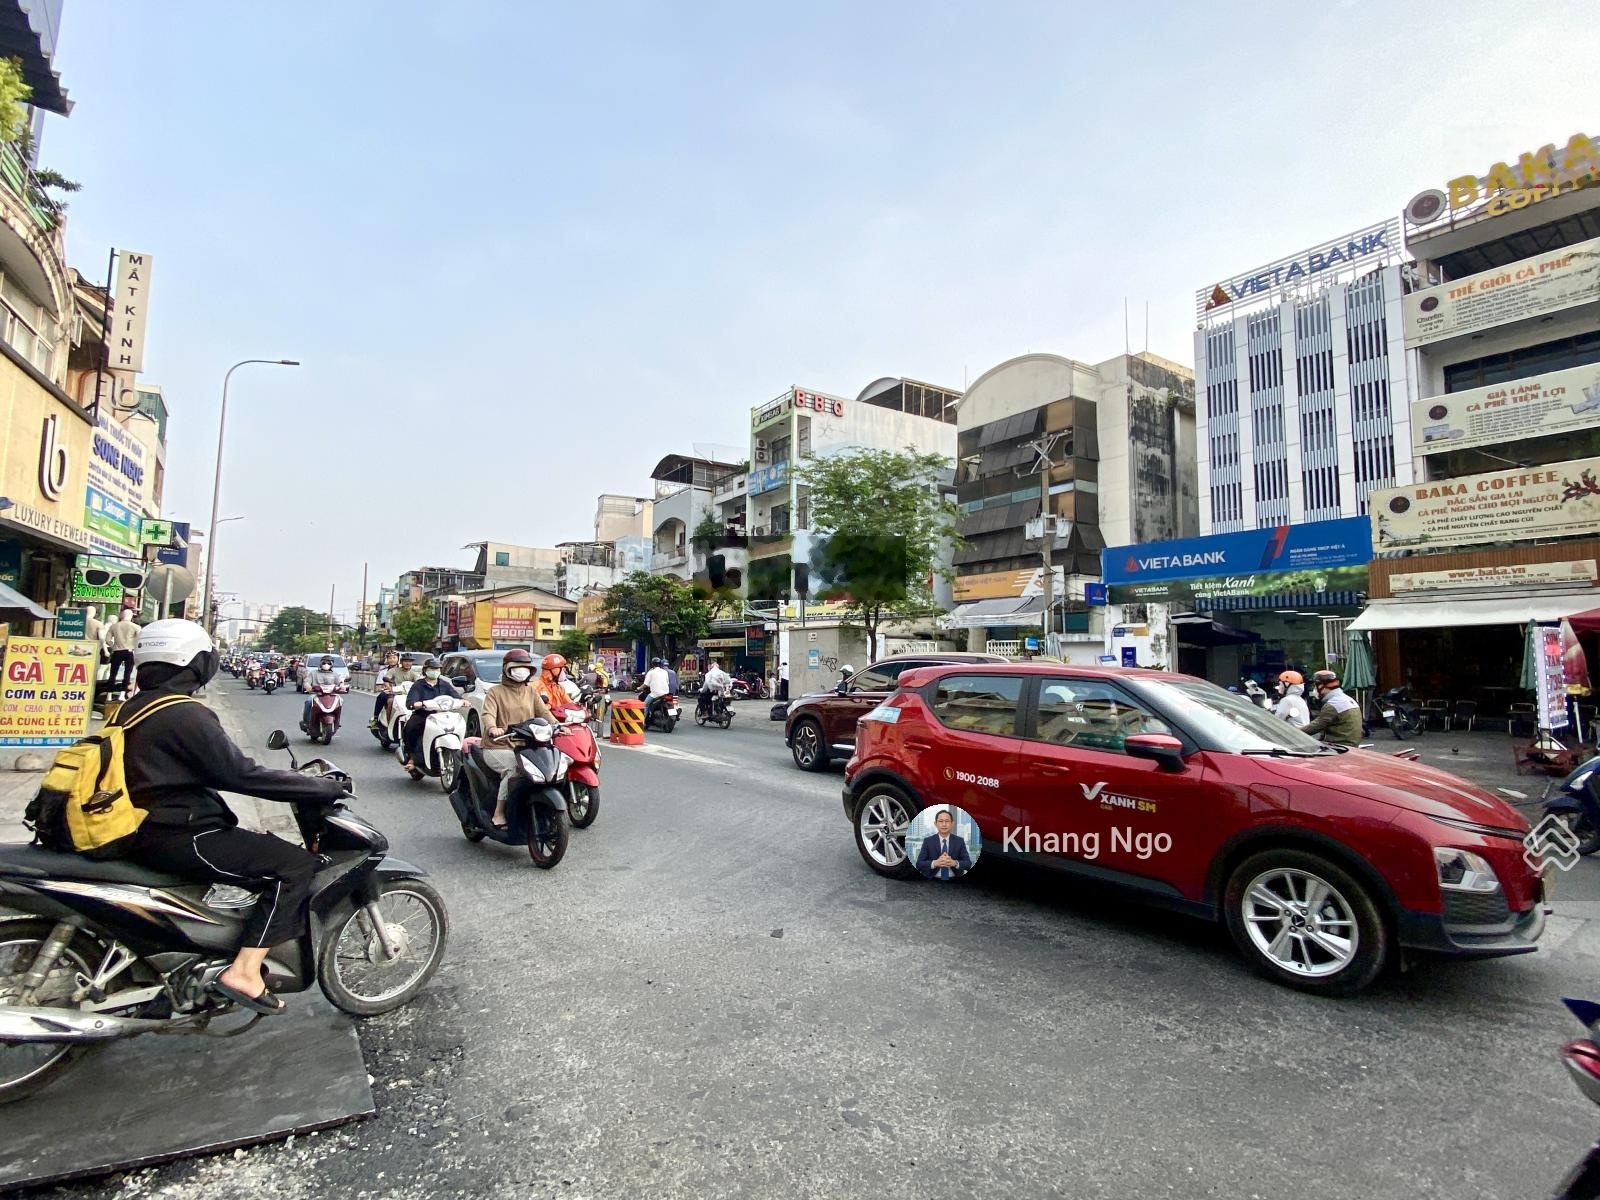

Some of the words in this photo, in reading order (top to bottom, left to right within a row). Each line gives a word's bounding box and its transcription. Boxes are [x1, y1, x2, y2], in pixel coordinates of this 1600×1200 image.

[93, 433, 120, 470] SONG
[1416, 484, 1468, 500] BAKA
[1476, 470, 1559, 492] COFFEE
[1490, 493, 1506, 501] GIA
[1508, 490, 1523, 498] LAI
[1450, 504, 1476, 514] NGON
[1478, 502, 1498, 511] CHO
[1496, 509, 1511, 518] CAO
[15, 504, 51, 531] LUXURY
[54, 520, 88, 543] EYEWEAR
[1138, 550, 1226, 570] VIETABANK
[1222, 574, 1256, 588] Xanh
[57, 630, 84, 638] SONG
[44, 646, 64, 655] CA
[8, 656, 43, 683] GÀ
[55, 663, 87, 684] TA
[5, 689, 36, 700] CƠM
[62, 691, 87, 701] 35K
[956, 771, 976, 783] 1900
[977, 775, 1000, 788] 2088
[1100, 793, 1136, 809] XANH
[1137, 801, 1156, 813] SM
